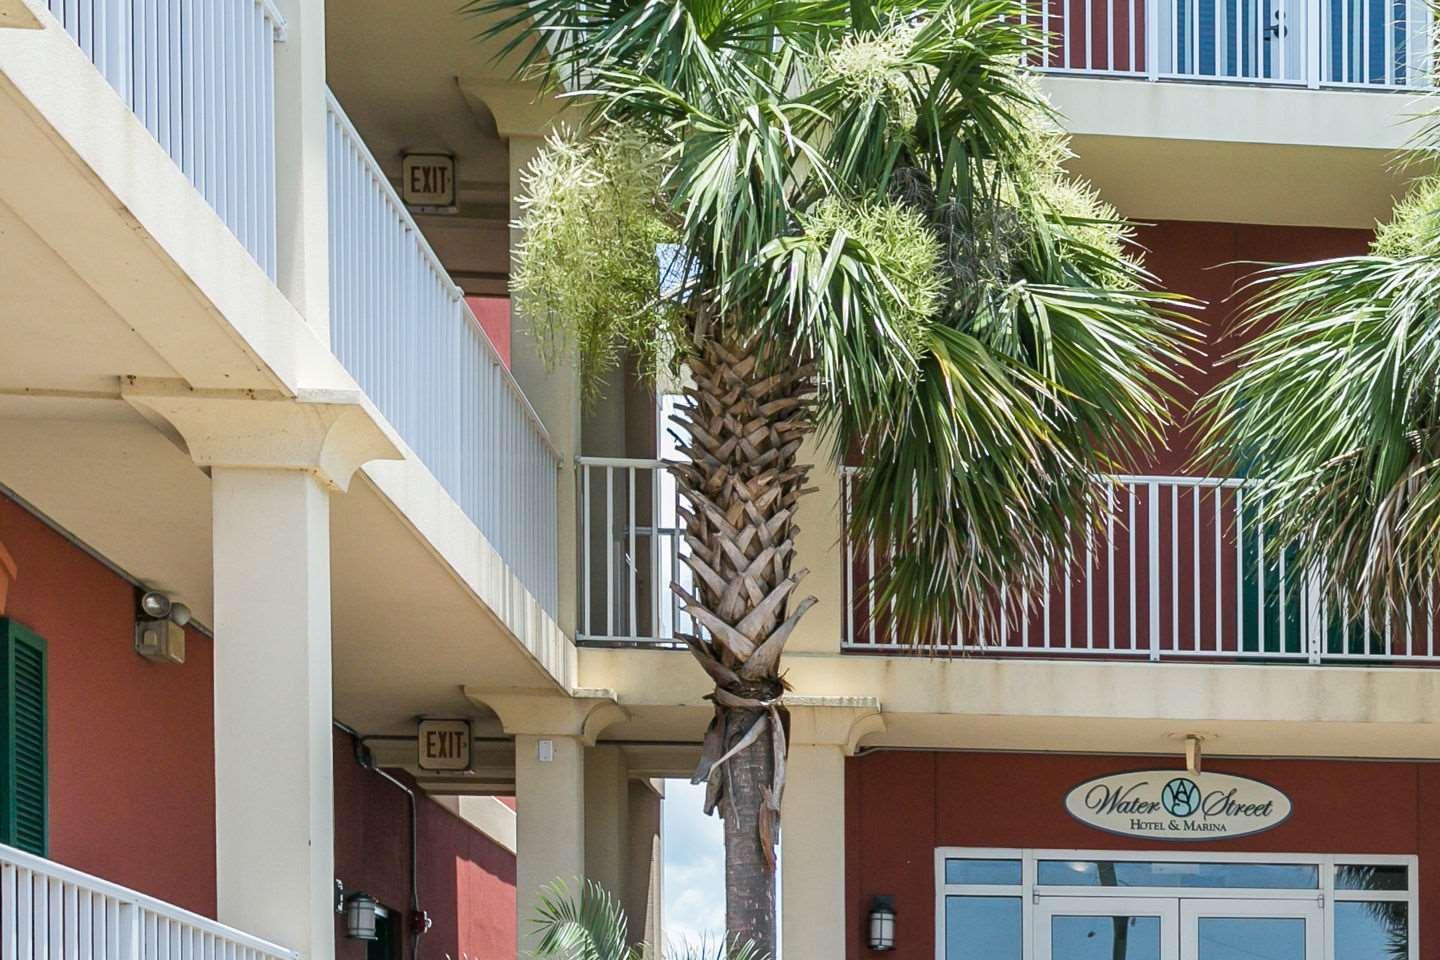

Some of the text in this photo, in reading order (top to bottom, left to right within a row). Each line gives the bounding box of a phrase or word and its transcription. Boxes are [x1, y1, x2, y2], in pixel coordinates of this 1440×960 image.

[410, 166, 448, 194] EXIT
[427, 731, 464, 758] EXIT
[1085, 782, 1274, 820] Water Street
[1168, 821, 1180, 831] &
